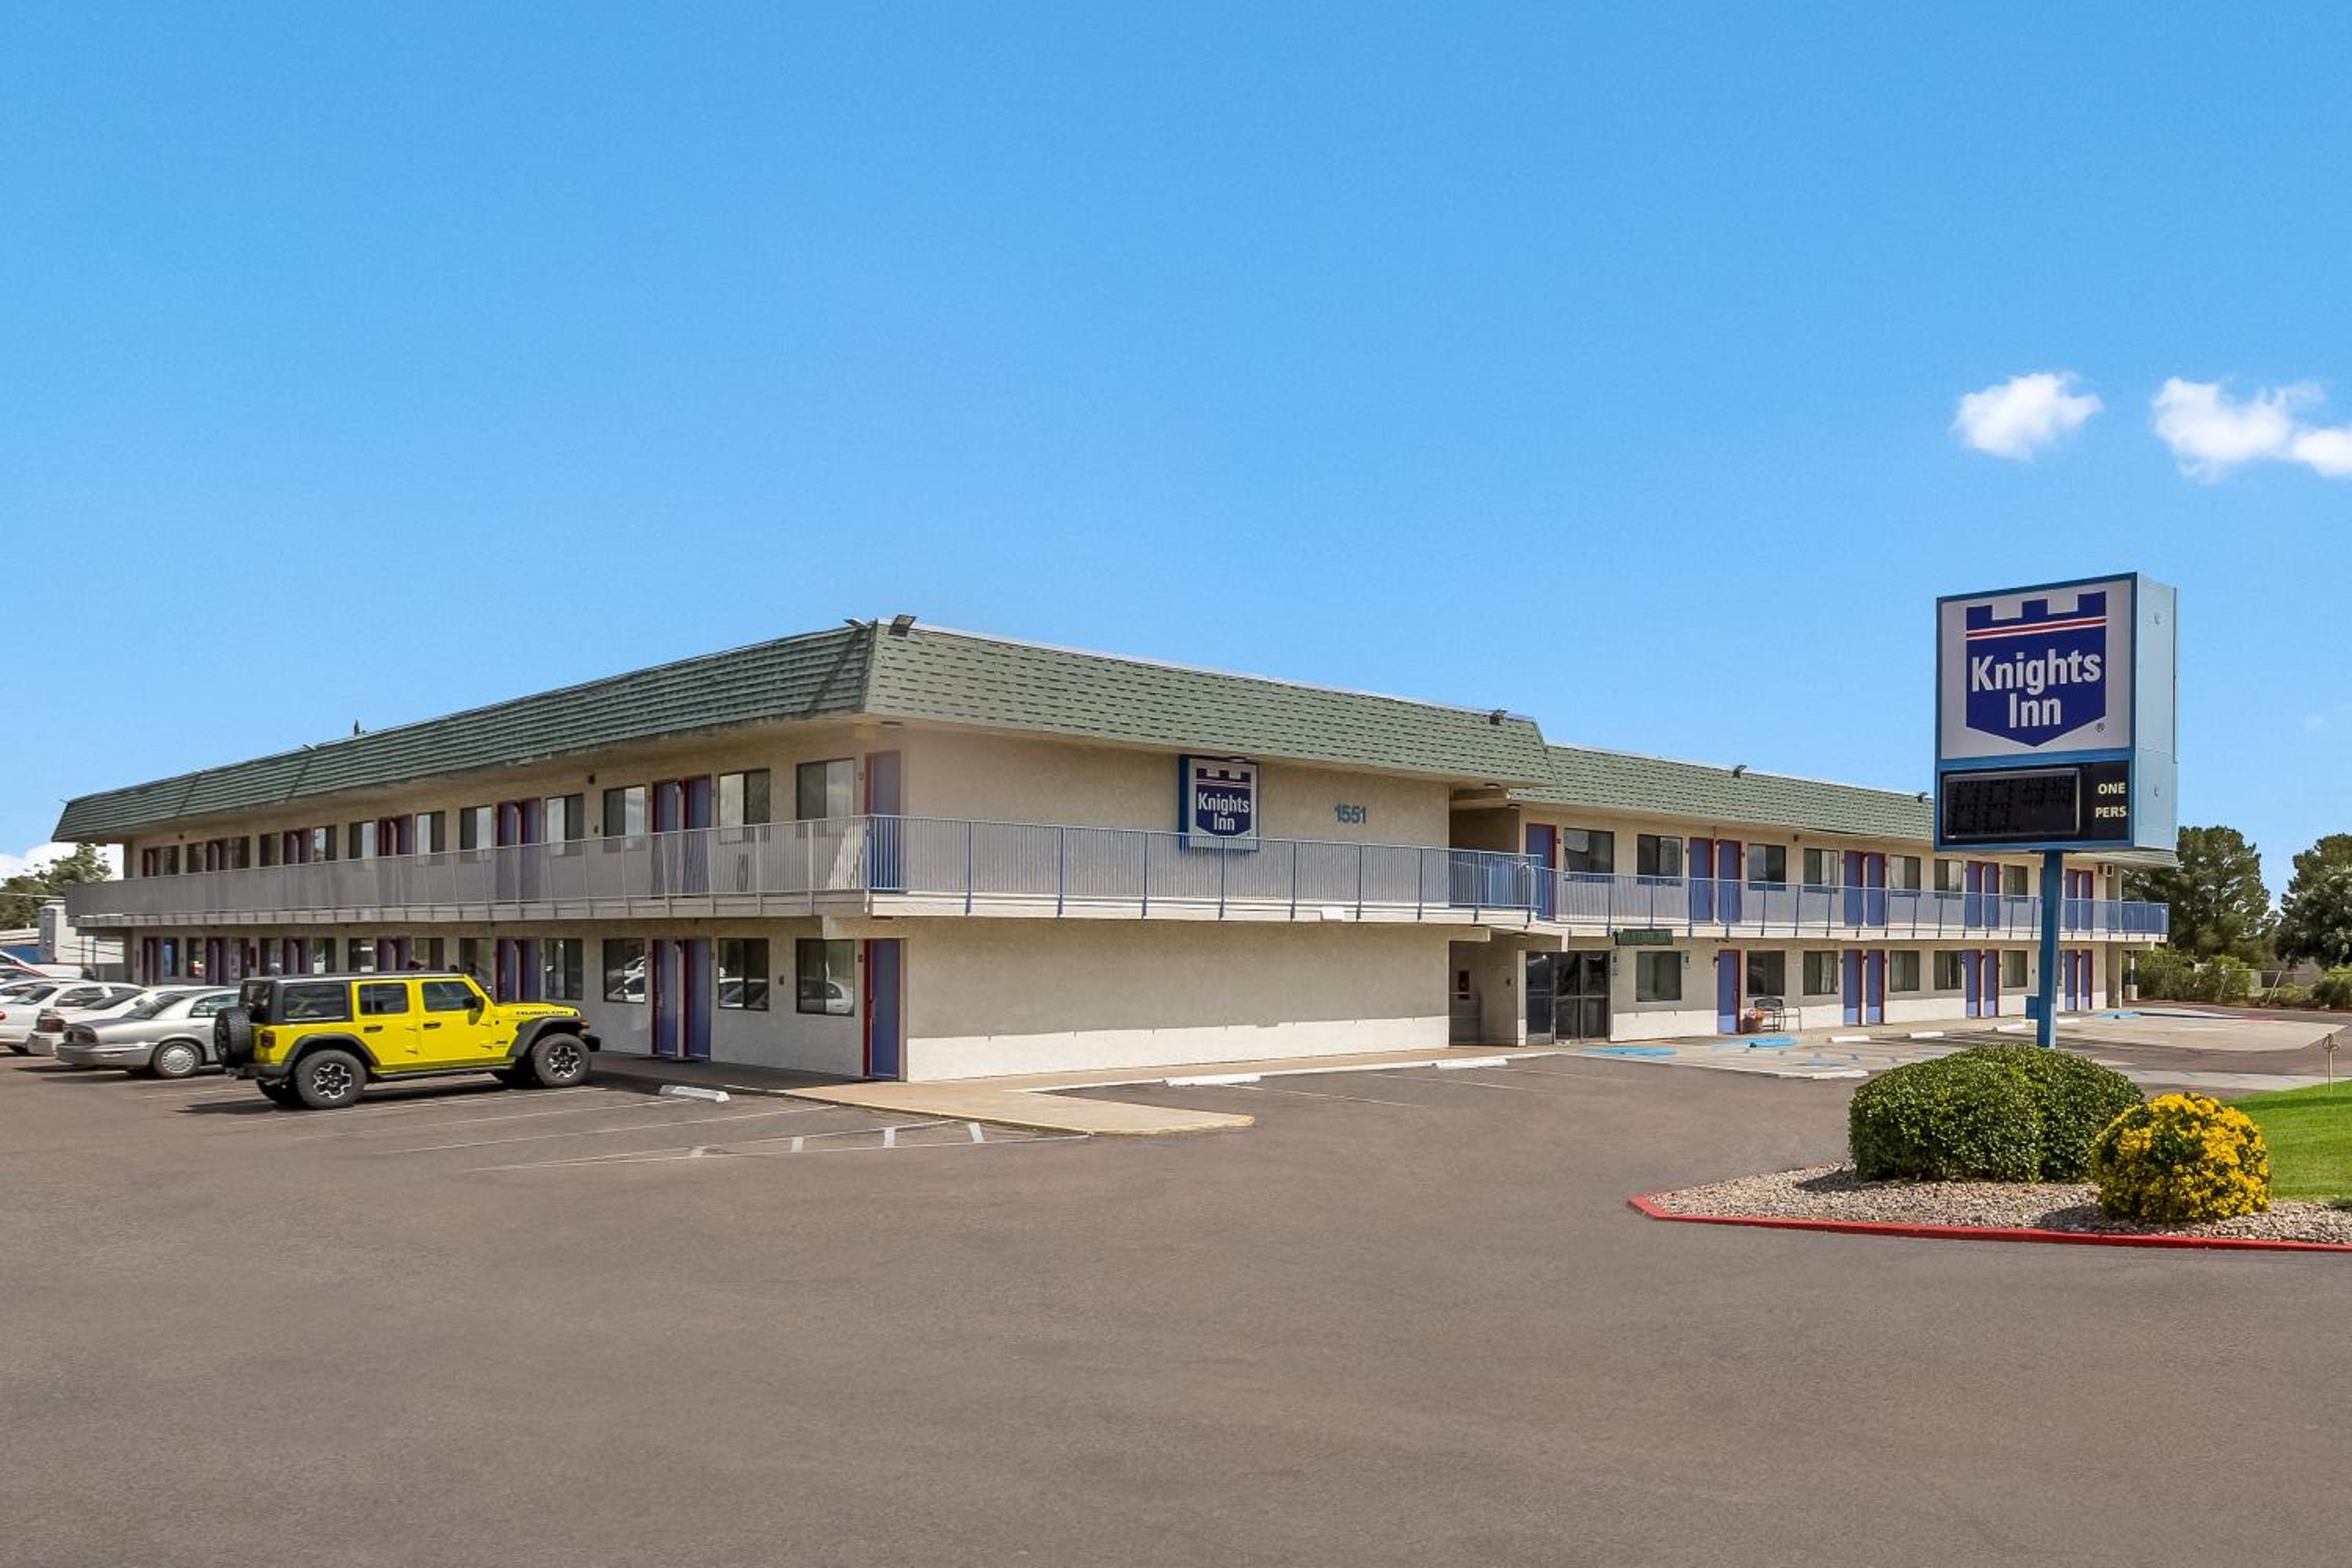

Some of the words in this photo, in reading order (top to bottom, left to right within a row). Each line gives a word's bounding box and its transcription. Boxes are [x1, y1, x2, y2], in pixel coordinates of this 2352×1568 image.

[1972, 649, 2101, 695] Knights
[2009, 694, 2061, 728] Inn
[2097, 782, 2126, 795] ONE
[1198, 793, 1250, 815] Knights
[1335, 803, 1366, 823] 1551
[2095, 806, 2127, 818] PERS
[1214, 813, 1235, 830] Inn
